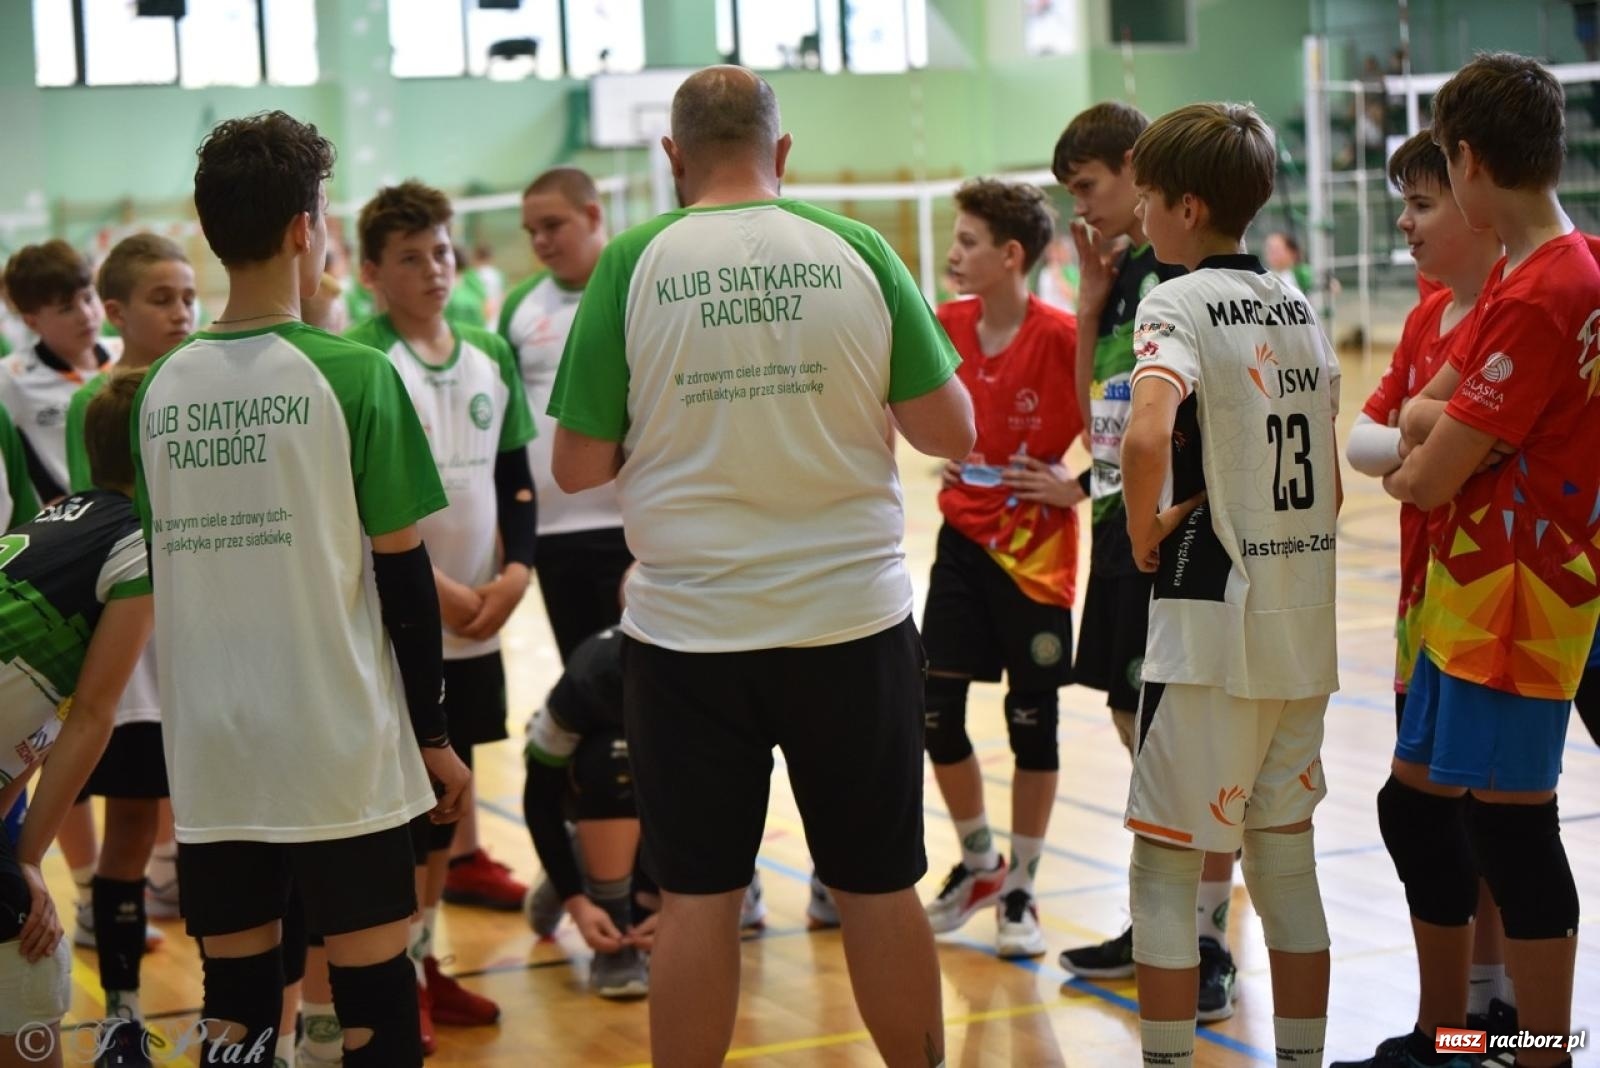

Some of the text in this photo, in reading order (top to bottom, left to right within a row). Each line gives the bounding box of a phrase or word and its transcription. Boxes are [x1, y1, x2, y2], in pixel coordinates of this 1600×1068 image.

[656, 264, 842, 305] KLUB SIATKARSKI
[701, 291, 803, 328] RACIBÓRZ
[675, 373, 685, 385] W
[687, 368, 734, 386] zdrowym
[736, 364, 761, 380] ciele
[763, 362, 797, 378] zdrowy
[1277, 367, 1320, 399] JSW
[680, 384, 746, 406] -profilaktyka
[749, 384, 775, 401] przez
[146, 395, 309, 441] KLUB SIATKARSKI
[167, 429, 267, 471] RACIBÓRZ
[1267, 414, 1314, 511] 23
[201, 512, 227, 528] ciele
[230, 511, 265, 528] zdrowy
[214, 535, 243, 553] przez
